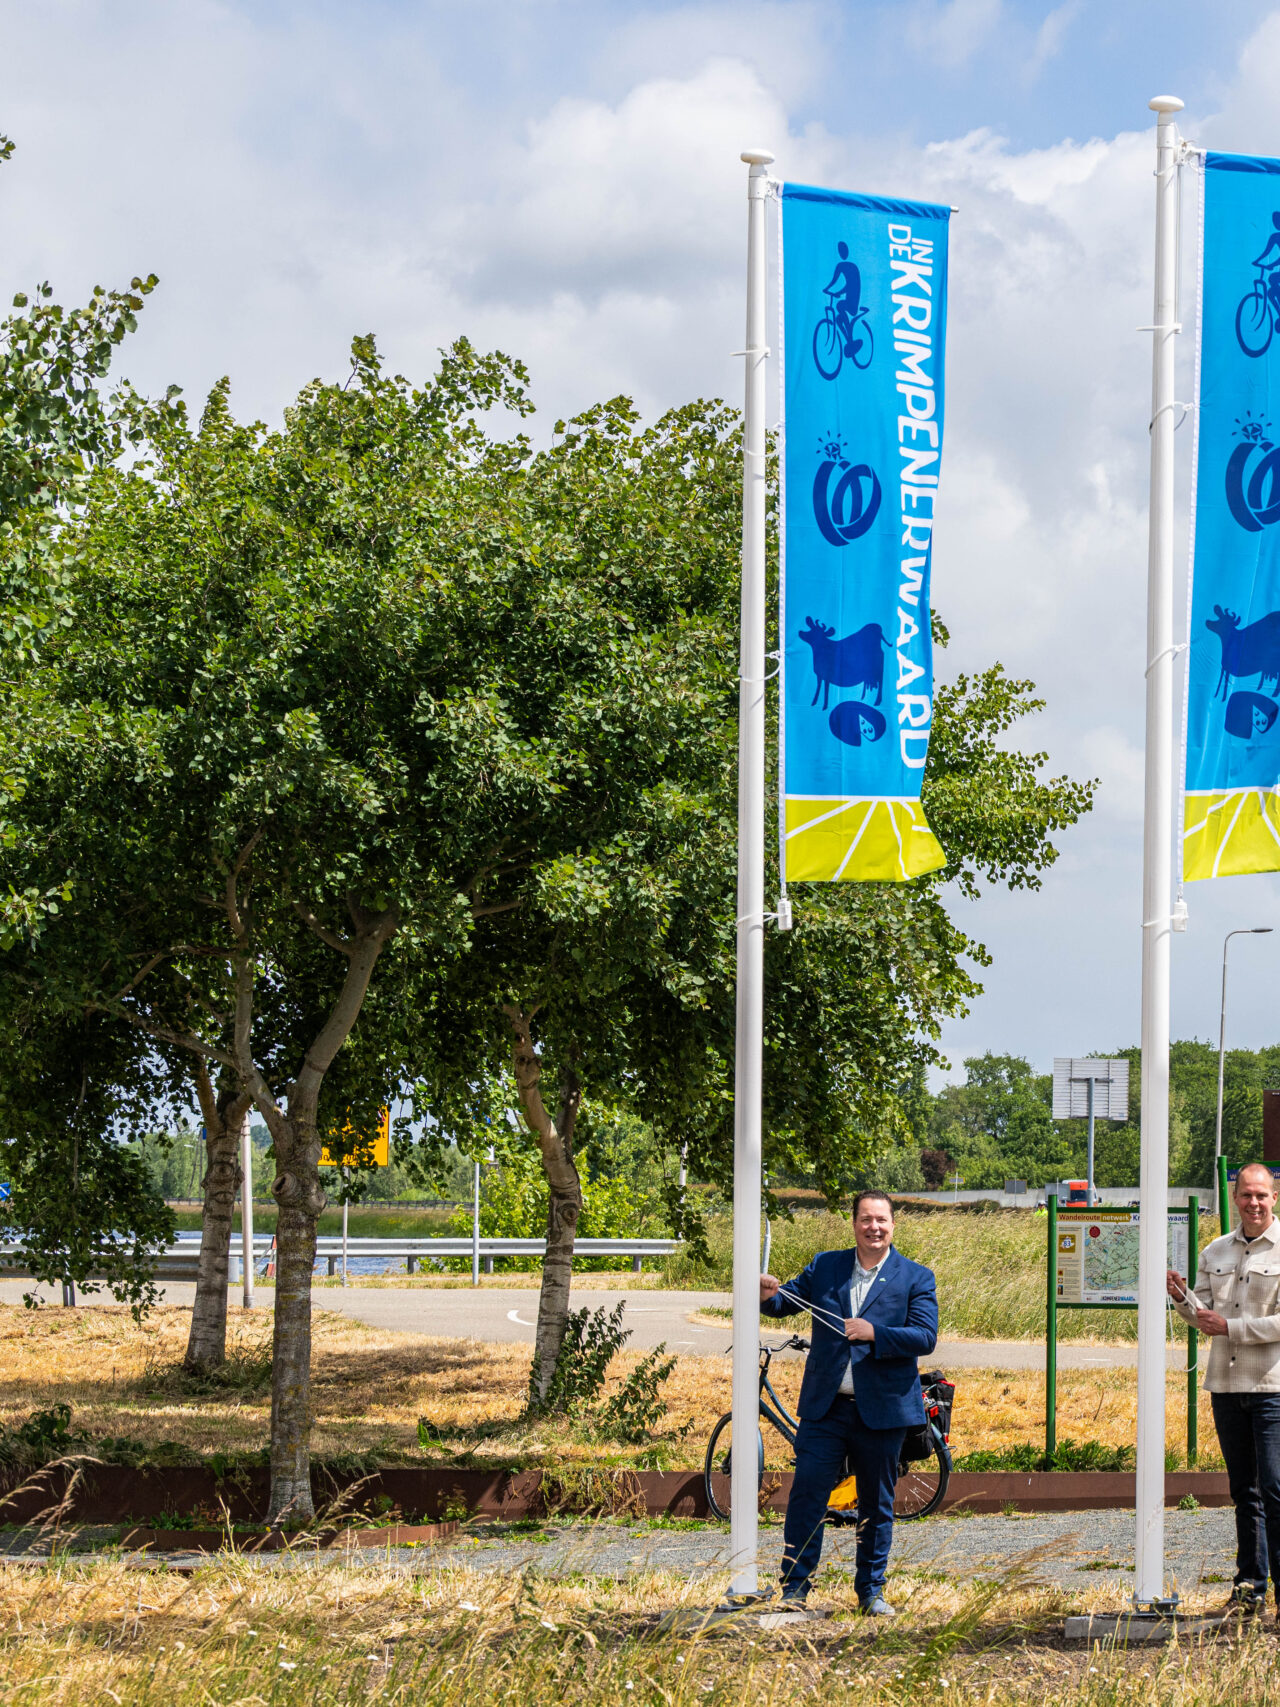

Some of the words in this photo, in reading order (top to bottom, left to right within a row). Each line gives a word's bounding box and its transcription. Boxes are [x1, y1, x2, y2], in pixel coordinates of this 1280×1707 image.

[888, 223, 912, 260] DE
[911, 237, 934, 264] IN
[890, 259, 939, 769] KRIMPENERWAARD
